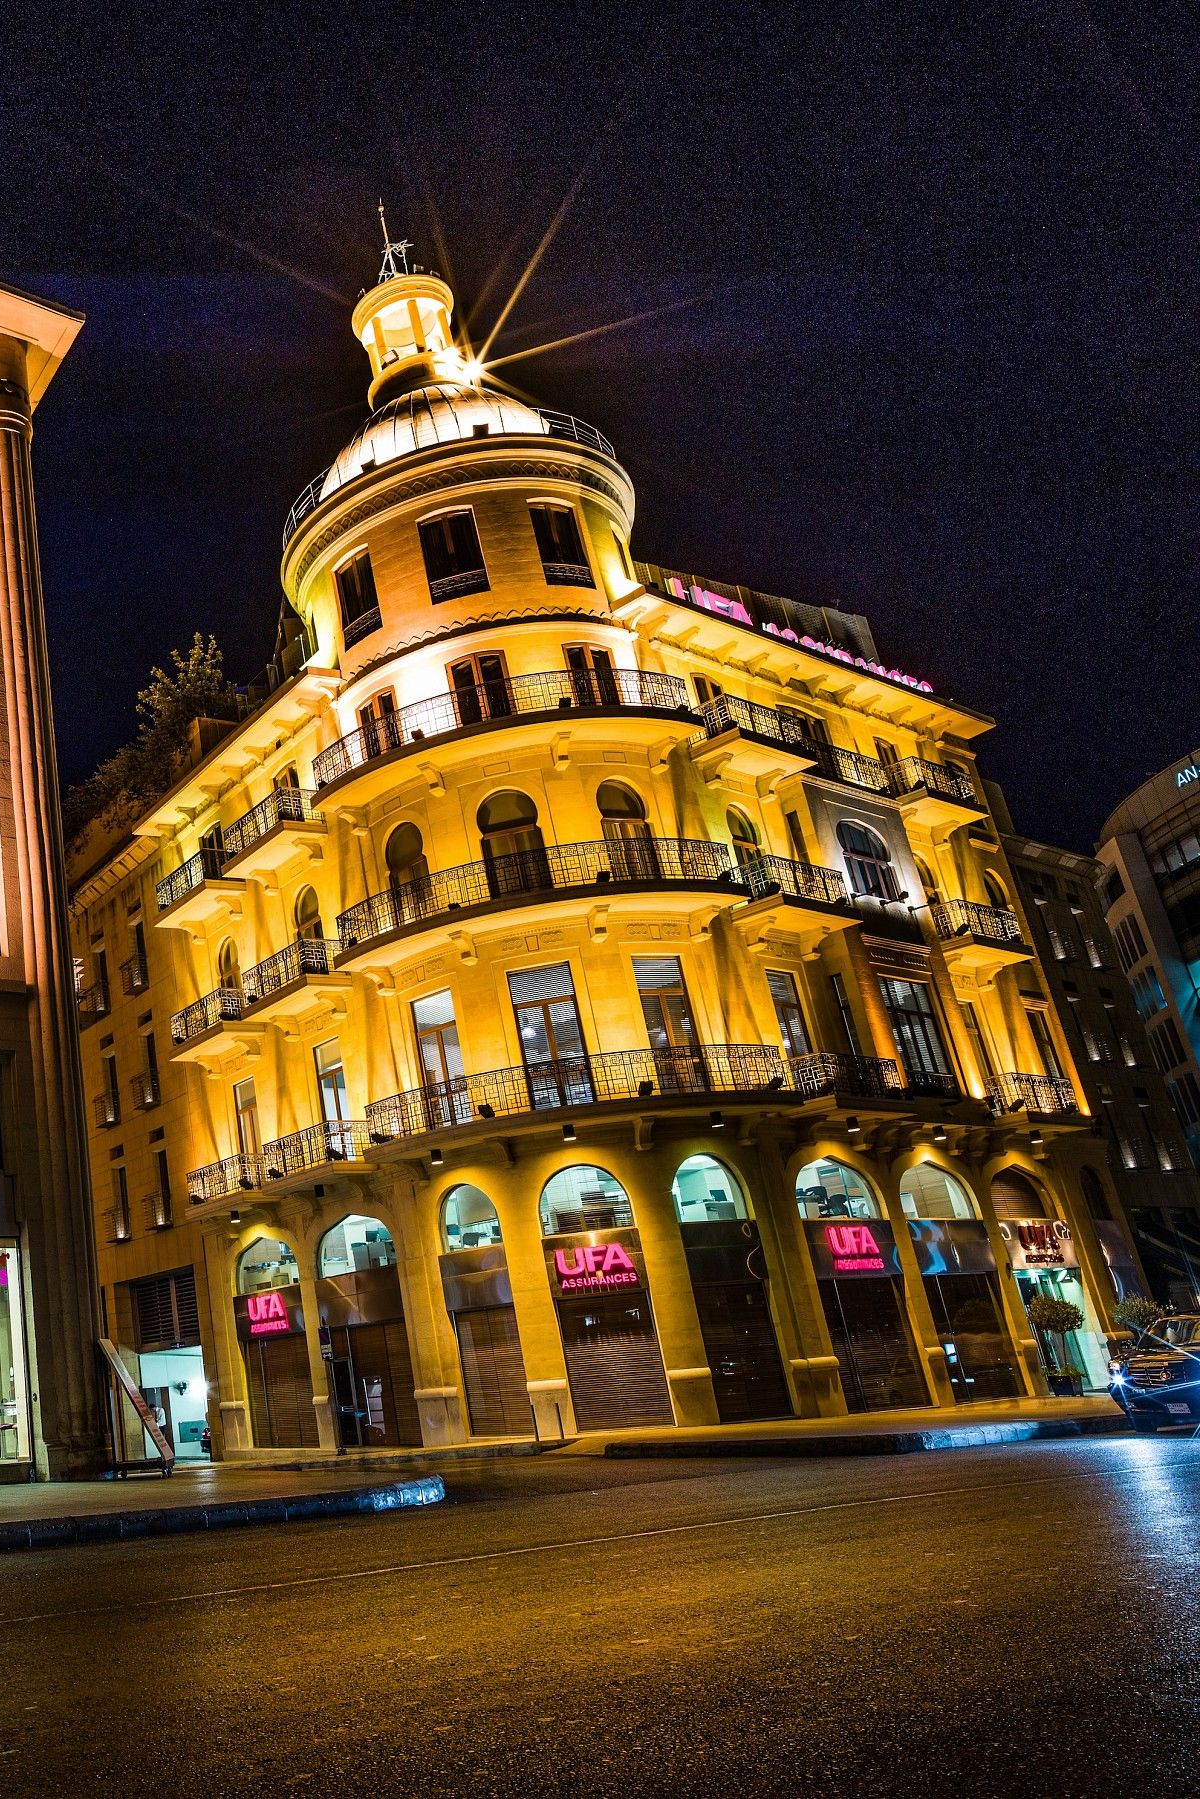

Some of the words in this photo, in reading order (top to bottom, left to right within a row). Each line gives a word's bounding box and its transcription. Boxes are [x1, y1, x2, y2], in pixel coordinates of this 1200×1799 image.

[1177, 765, 1200, 787] AN
[826, 1226, 880, 1255] UFA
[555, 1243, 633, 1274] UFA
[561, 1272, 637, 1289] ASSURANCES
[247, 1293, 285, 1321] UFA
